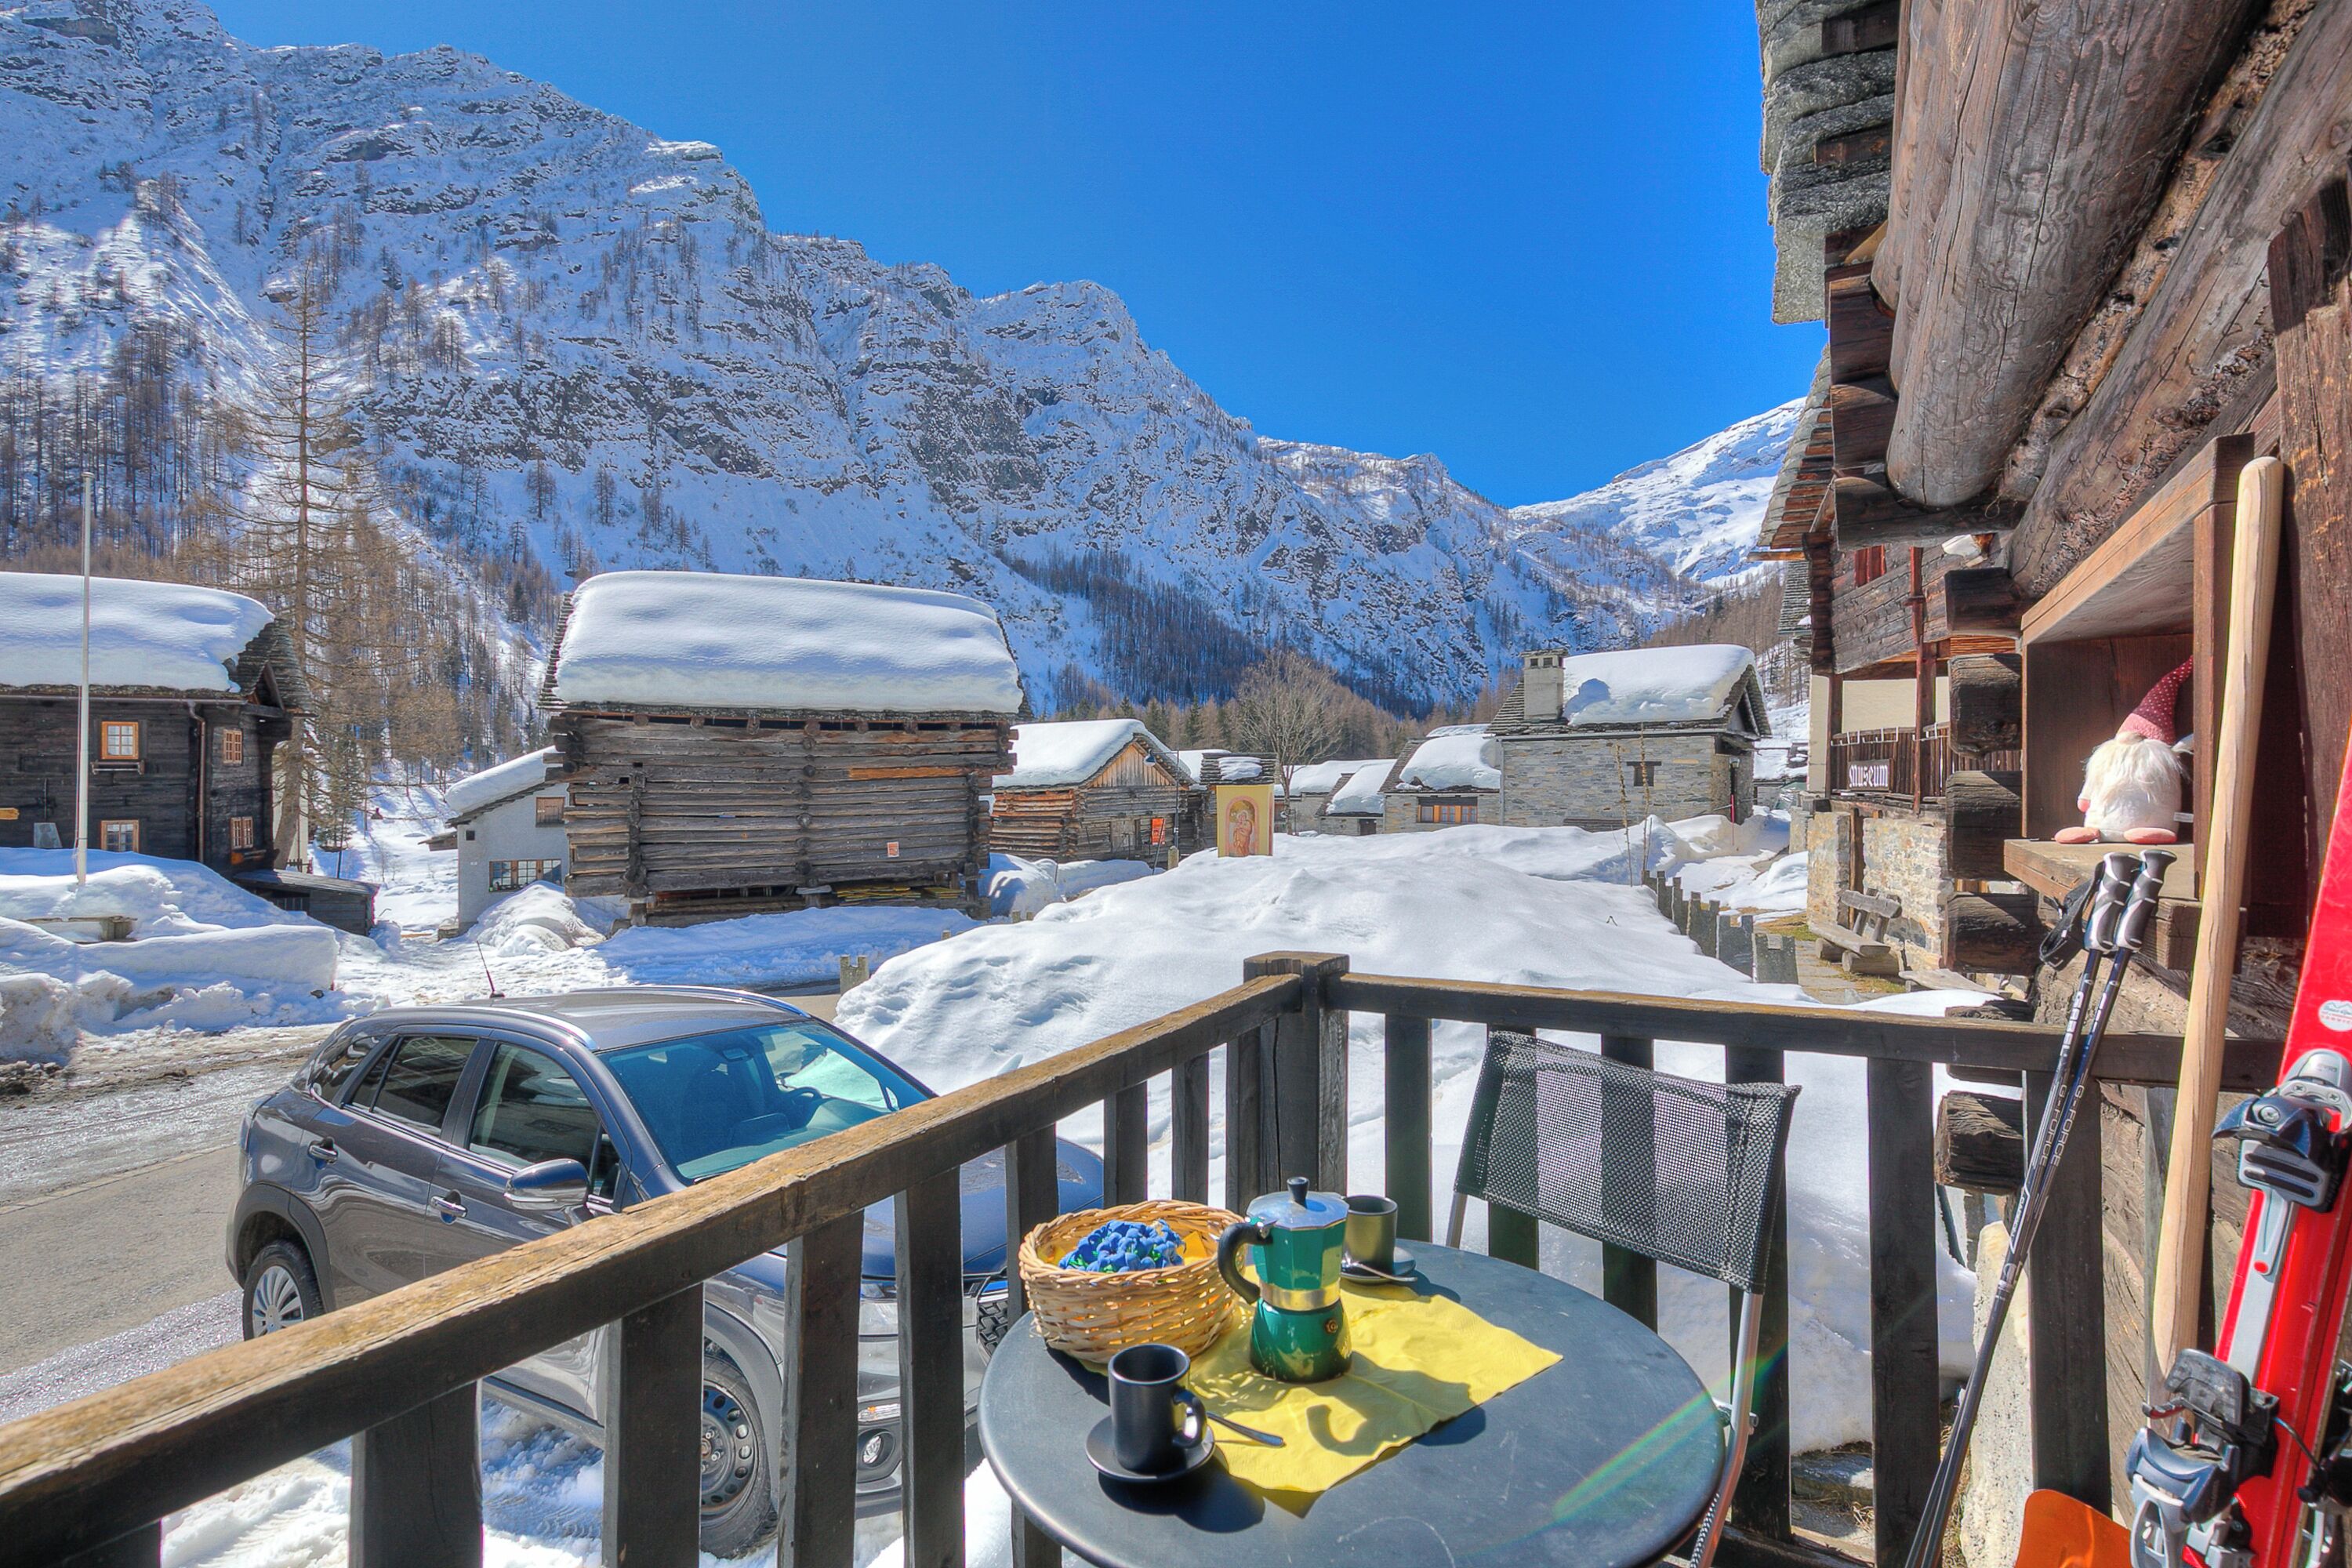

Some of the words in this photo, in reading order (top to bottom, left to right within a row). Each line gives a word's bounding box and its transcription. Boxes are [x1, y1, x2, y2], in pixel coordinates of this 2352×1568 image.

[1849, 764, 1889, 788] Museum
[2039, 1084, 2067, 1167] G-FORCE
[2050, 1085, 2085, 1167] G-FORCE
